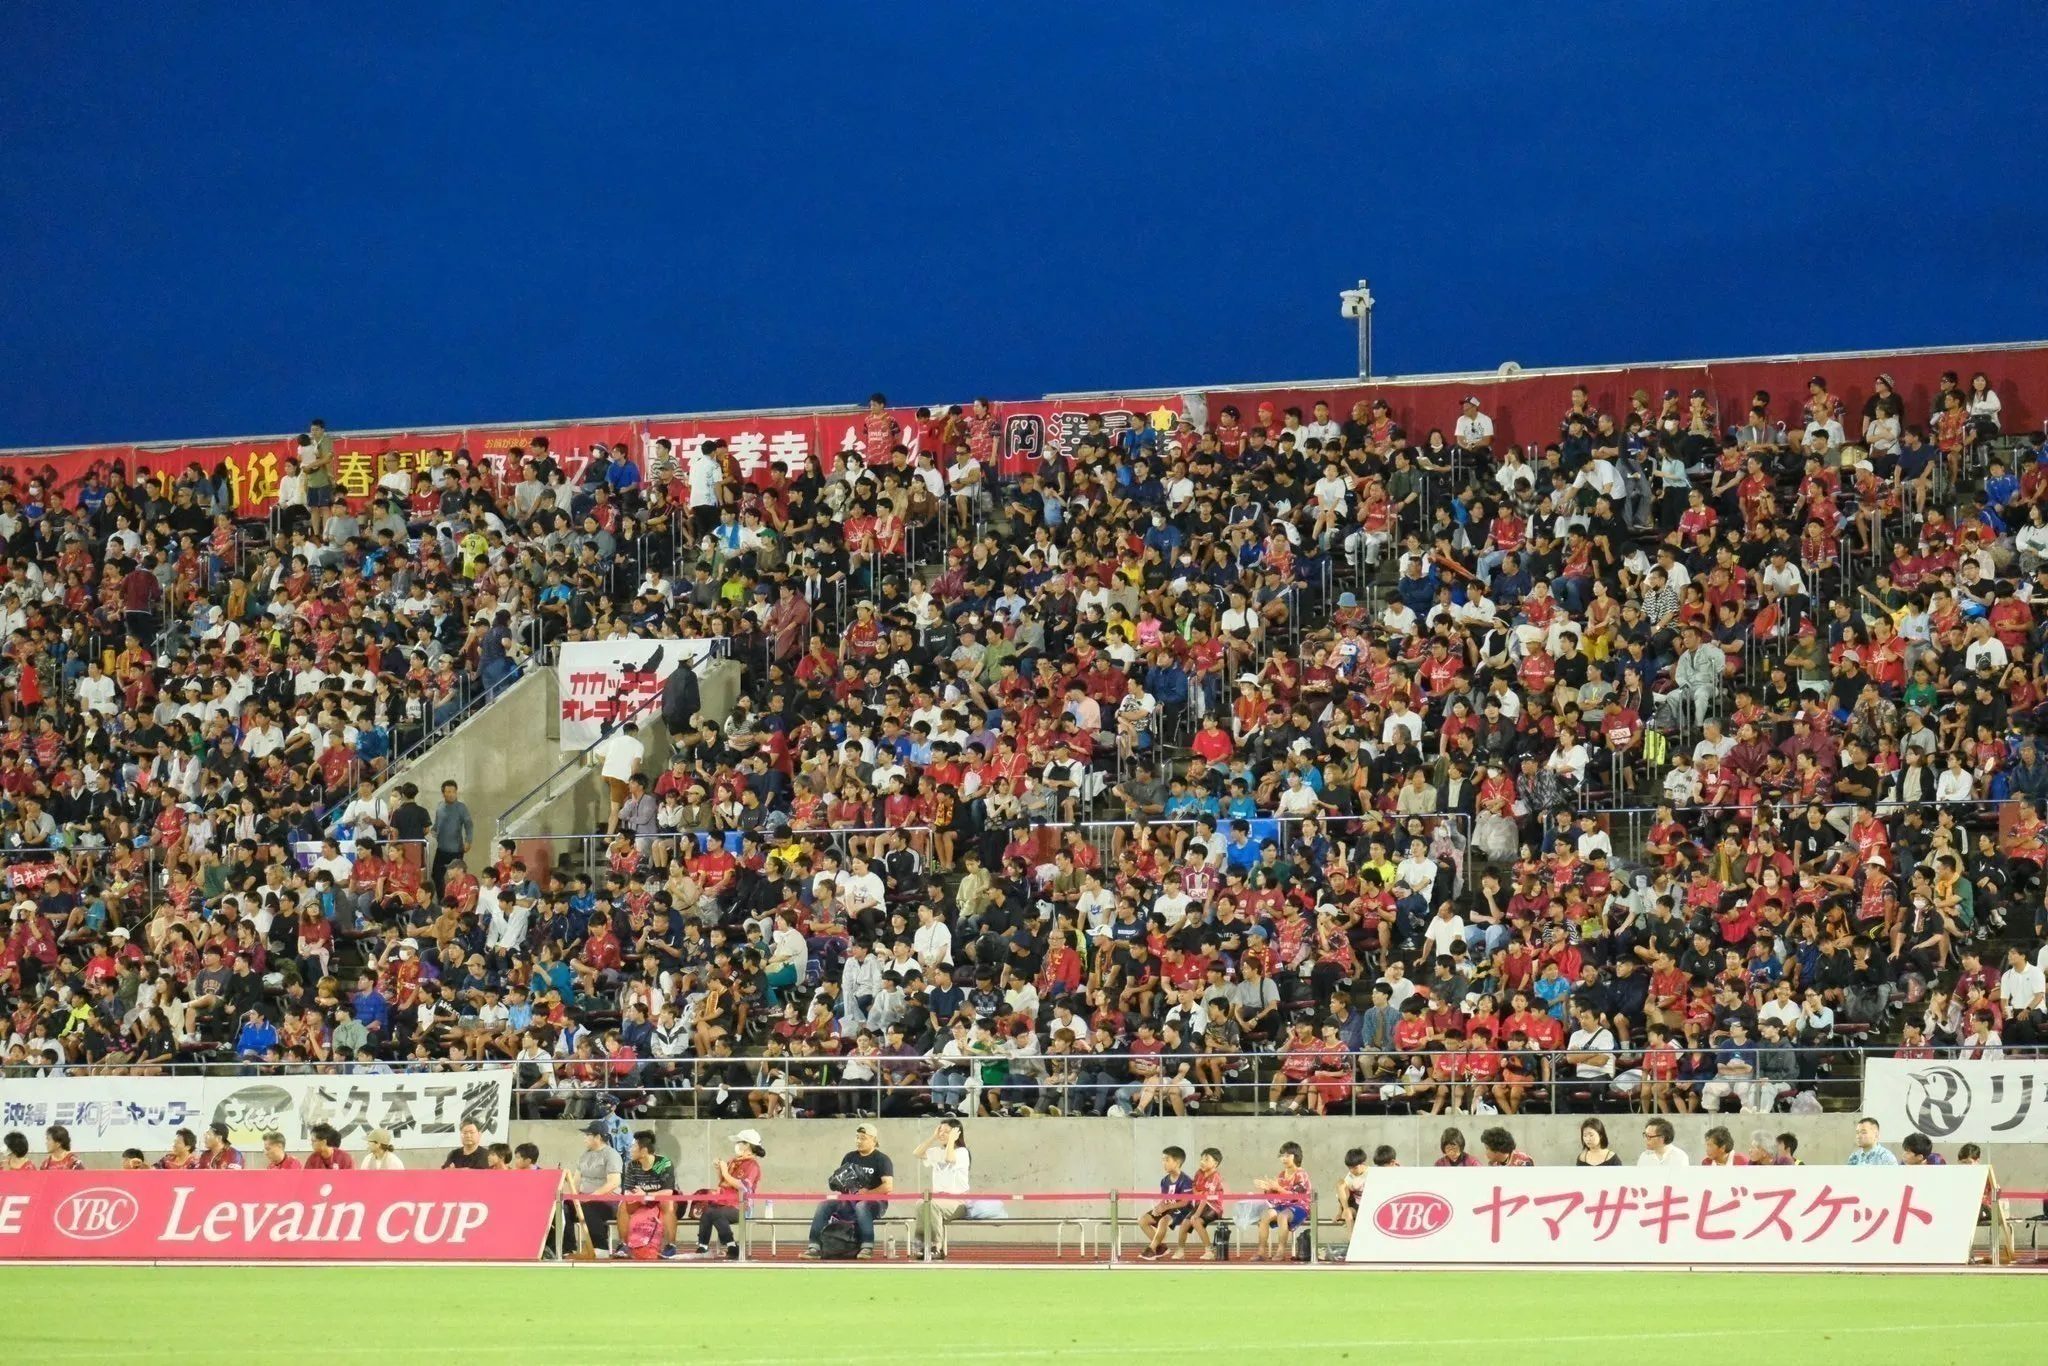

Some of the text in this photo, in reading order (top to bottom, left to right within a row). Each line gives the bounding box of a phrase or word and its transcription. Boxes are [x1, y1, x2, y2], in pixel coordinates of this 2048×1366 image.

[4, 1101, 48, 1127] 沖縄
[0, 1196, 30, 1234] E
[69, 1198, 128, 1231] YBC
[158, 1184, 489, 1243] Levain CUP
[1387, 1201, 1443, 1231] YBC
[1472, 1185, 1934, 1244] ヤマザキビスケット
